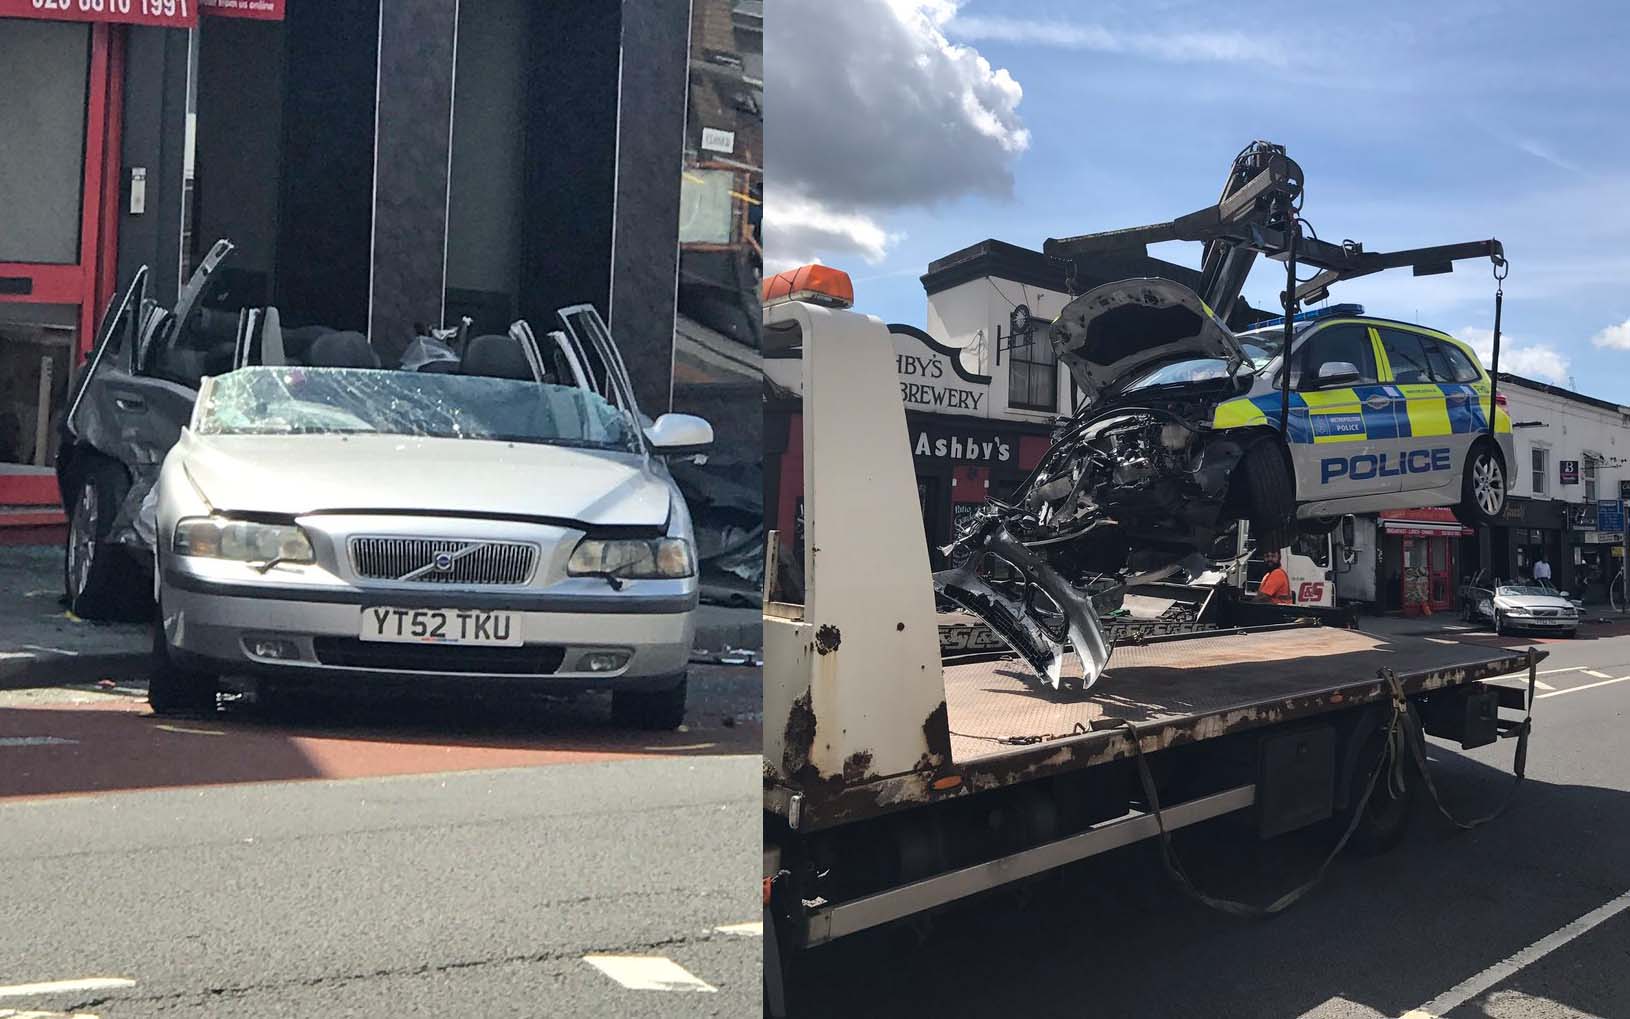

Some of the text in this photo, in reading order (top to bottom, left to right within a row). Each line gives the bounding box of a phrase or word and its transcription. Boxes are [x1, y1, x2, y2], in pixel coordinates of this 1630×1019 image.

[249, 2, 274, 11] online
[900, 382, 984, 410] BREWERY
[1336, 424, 1360, 432] POLICE
[915, 432, 1010, 461] Ashby's
[1321, 448, 1451, 484] POLICE
[374, 609, 510, 640] YT52 TKU
